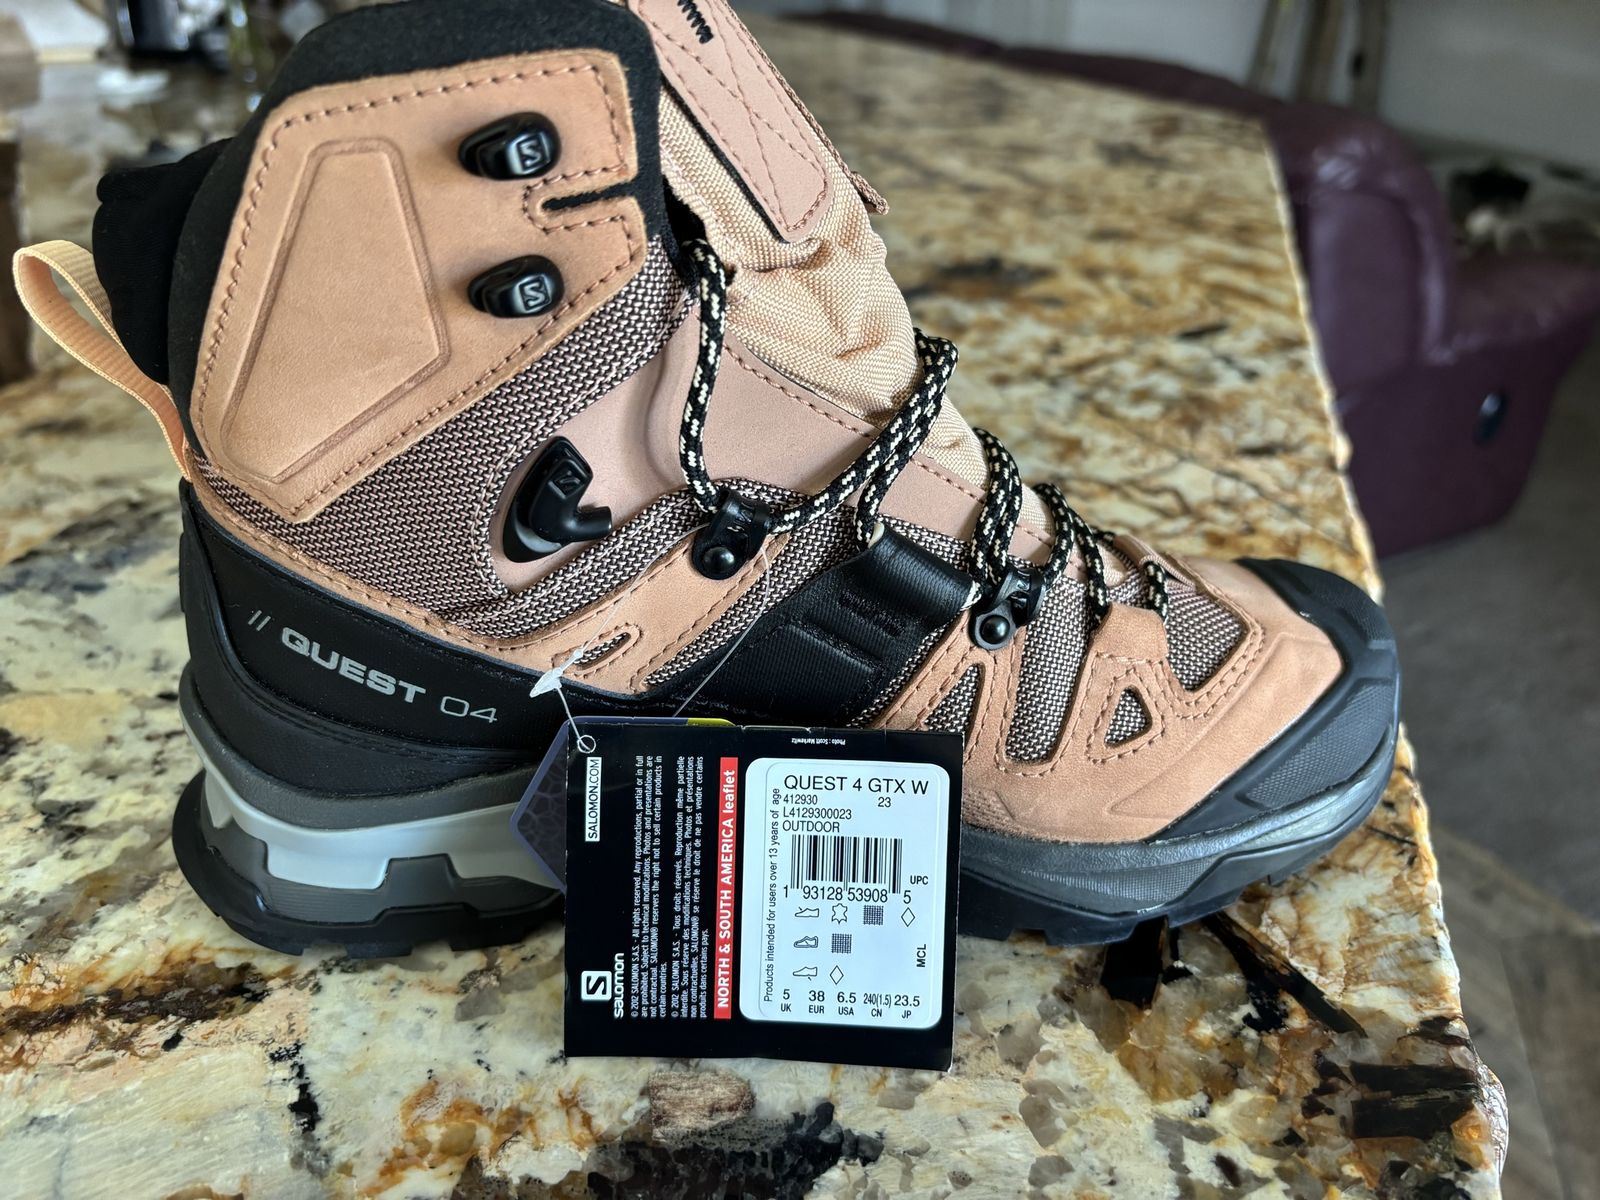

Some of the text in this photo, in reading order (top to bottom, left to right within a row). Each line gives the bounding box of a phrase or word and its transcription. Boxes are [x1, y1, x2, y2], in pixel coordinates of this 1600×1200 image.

[281, 626, 426, 703] QUEST
[440, 695, 498, 723] 04
[635, 755, 644, 767] full
[676, 756, 685, 785] partielle
[695, 756, 703, 784] certains
[636, 778, 644, 786] or
[654, 765, 662, 796] products
[684, 756, 694, 803] présentations
[784, 775, 929, 794] QUEST 4 GTX W
[588, 758, 600, 839] SALOMON.COM
[634, 787, 643, 810] partial
[644, 769, 653, 815] presentations
[675, 787, 684, 809] même
[694, 786, 702, 810] vendre
[783, 794, 891, 807] 412930 23
[653, 797, 662, 822] certain
[783, 807, 852, 819] L4129300023
[634, 811, 643, 859] reproductions,
[643, 817, 652, 830] and
[652, 823, 661, 836] sell
[674, 812, 684, 856] Reproduction
[684, 815, 693, 839] Photos
[694, 827, 702, 836] ne
[782, 820, 840, 832] OUTDOOR
[643, 831, 652, 855] Photos
[652, 837, 661, 846] to
[652, 848, 660, 859] not
[693, 838, 702, 848] de
[633, 860, 642, 874] Any
[651, 861, 661, 878] right
[683, 841, 692, 879] techniques.
[692, 850, 701, 866] droit
[642, 856, 651, 902] modifications.
[651, 880, 660, 892] the
[673, 859, 682, 889] réservés.
[910, 876, 928, 884] UPC
[633, 876, 641, 906] reserved.
[692, 877, 700, 903] réserve
[717, 770, 735, 1008] NORTH & SOUTH AMERICA leaflet
[764, 788, 780, 1002] Products intended for users over 13 years of age
[803, 886, 843, 900] 93128
[848, 888, 888, 903] 53908
[673, 892, 682, 912] droits
[682, 881, 691, 926] modifications
[693, 905, 700, 914] se
[632, 907, 641, 928] rights
[641, 904, 650, 934] technical
[672, 914, 681, 930] Tous
[632, 928, 640, 938] All
[682, 928, 690, 940] des
[631, 944, 640, 962] S.A.S.
[640, 944, 650, 969] Subject
[672, 940, 681, 958] S.A.S.
[681, 942, 690, 968] réserve
[700, 946, 708, 973] certains
[916, 944, 926, 968] MCL
[614, 952, 625, 1018] salomon
[631, 963, 640, 994] SALOMON
[649, 966, 658, 1004] contractual.
[671, 960, 680, 991] SALOMON
[681, 970, 689, 986] Sous
[690, 955, 698, 1003] contractuelles.
[640, 971, 649, 1005] prohibited.
[783, 989, 920, 1008] 5 38 6.5 240(1.5) 23.5
[630, 995, 639, 1010] 2012
[649, 1006, 657, 1018] not
[658, 994, 667, 1018] certain
[671, 993, 680, 1009] 2012
[680, 988, 689, 1018] interdite.
[699, 991, 708, 1018] produits
[781, 1003, 912, 1019] UK EUR USA CN JP
